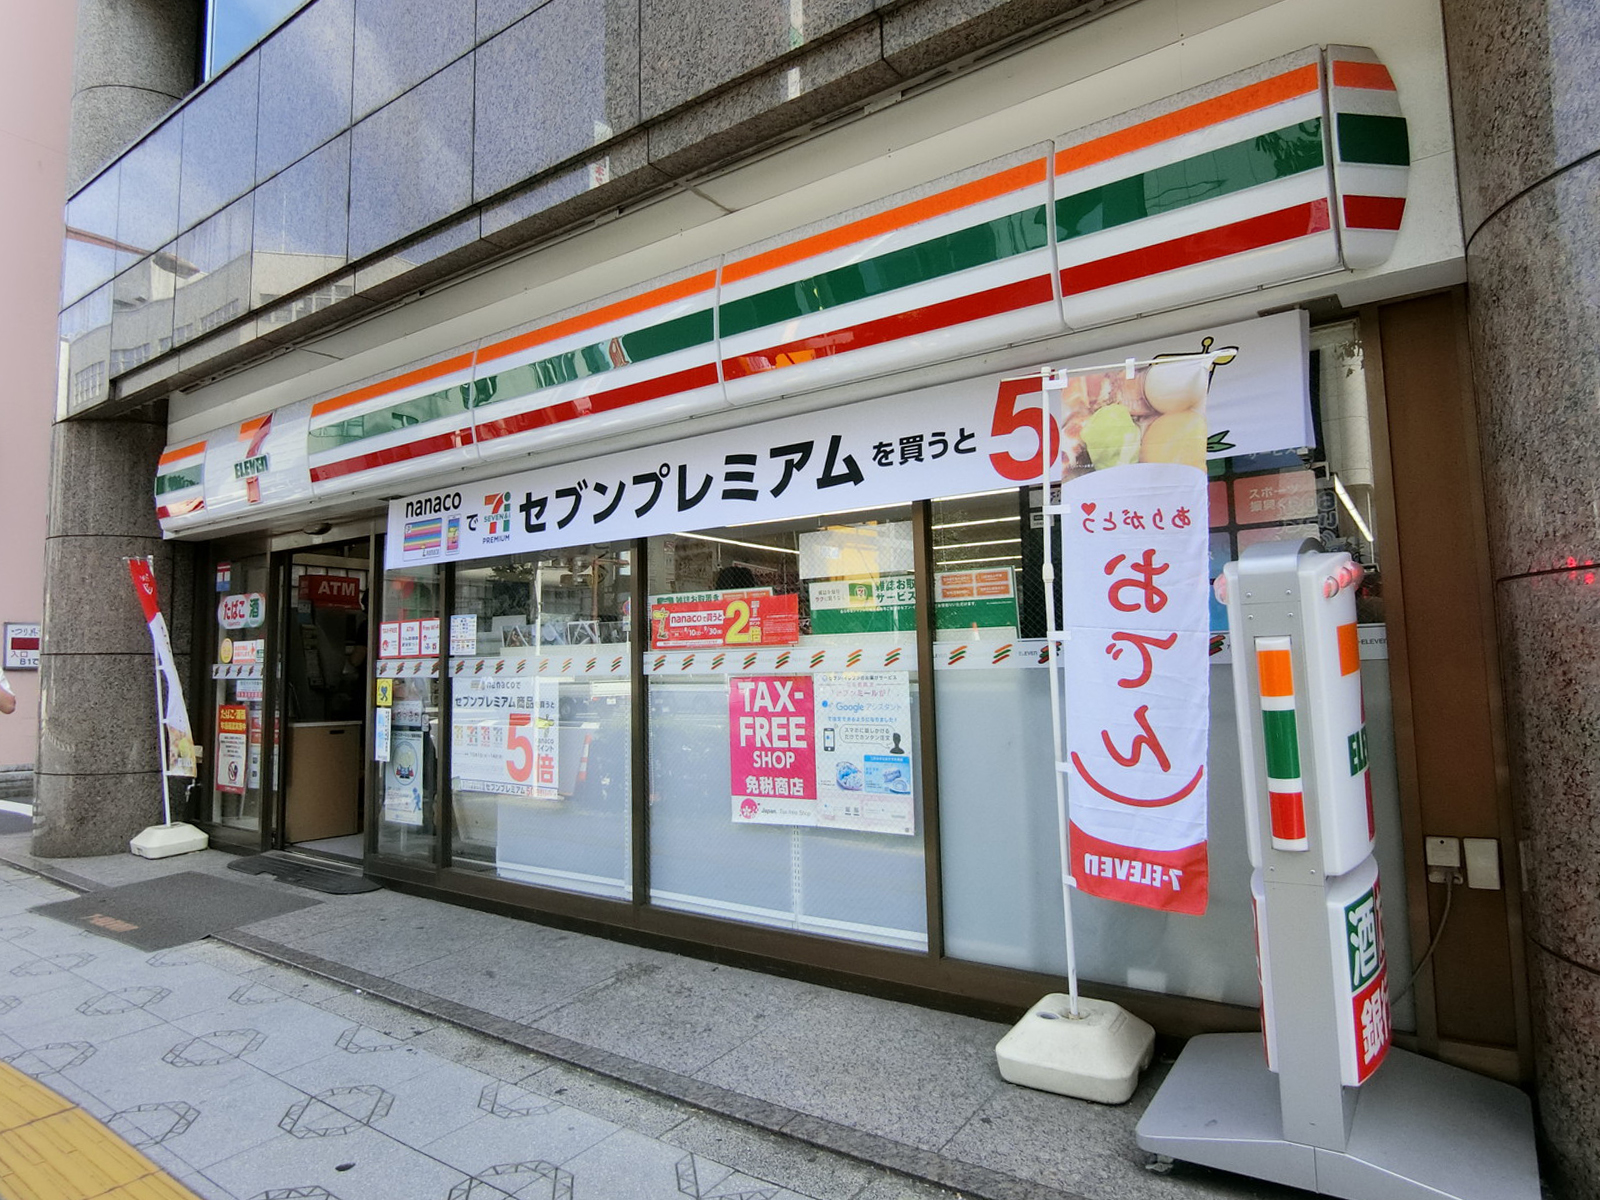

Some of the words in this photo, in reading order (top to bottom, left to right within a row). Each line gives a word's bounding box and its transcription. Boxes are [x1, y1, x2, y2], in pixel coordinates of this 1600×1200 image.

[238, 412, 274, 503] 7
[405, 492, 462, 518] nanaco
[466, 513, 479, 532] で
[519, 434, 865, 534] セブンプレミアム
[872, 428, 976, 467] を買うと
[989, 372, 1060, 481] 5
[1249, 484, 1298, 499] スポーツ
[482, 534, 510, 544] PREMIUM
[318, 581, 355, 596] ATM
[876, 590, 916, 603] サービス
[223, 600, 245, 620] たばこ
[249, 598, 260, 618] 酒
[738, 681, 804, 713] TAX-
[836, 702, 864, 713] Google
[739, 716, 807, 748] FREE
[506, 713, 534, 782] 5
[537, 753, 554, 783] 倍
[753, 751, 796, 769] SHOP
[745, 775, 804, 796] 免税商店
[1348, 896, 1378, 986] 酒
